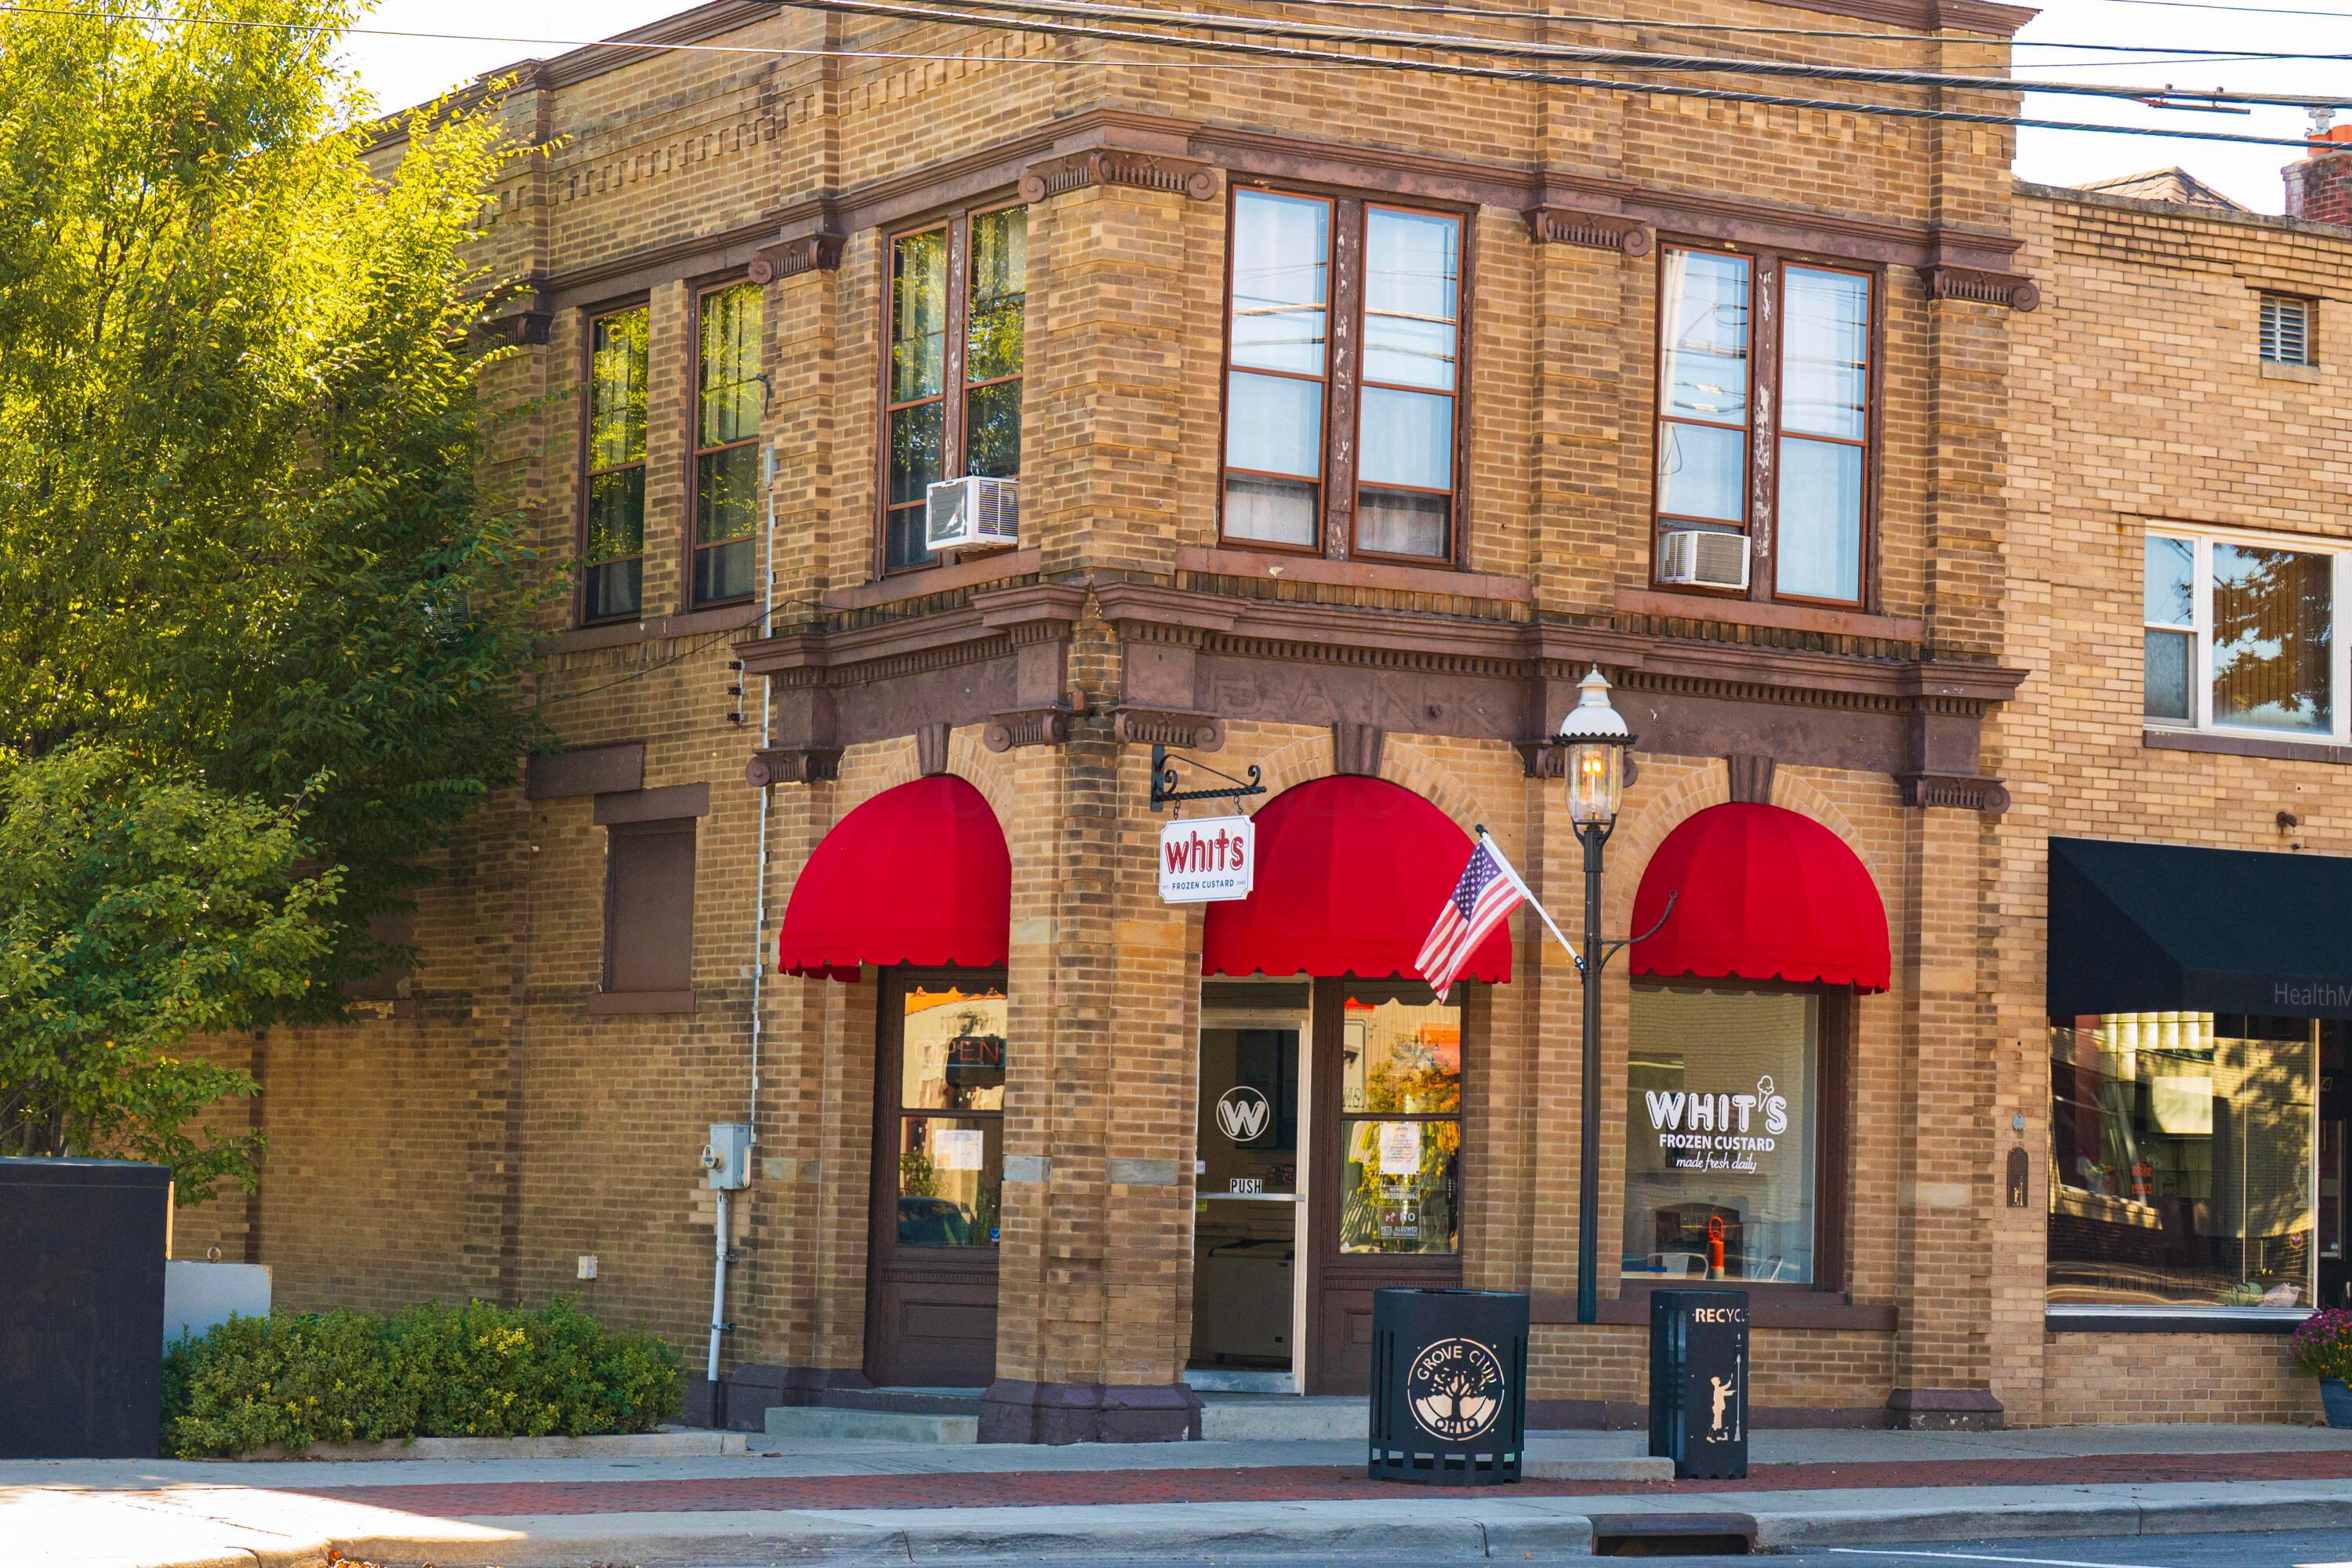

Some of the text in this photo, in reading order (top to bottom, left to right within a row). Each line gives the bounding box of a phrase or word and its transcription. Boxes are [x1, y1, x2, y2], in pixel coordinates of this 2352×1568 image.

[1172, 882, 1200, 891] FROZEN
[1202, 879, 1234, 889] CUSTARD
[1646, 1076, 1788, 1134] WHIT'S
[1220, 1100, 1266, 1136] W
[1659, 1134, 1775, 1152] FROZEN CUSTARD
[1676, 1151, 1757, 1174] made fresh daily
[1231, 1179, 1261, 1193] PUSH
[1399, 1212, 1415, 1221] NO
[1417, 1345, 1462, 1380] GROVE
[1435, 1417, 1479, 1434] OHIO
